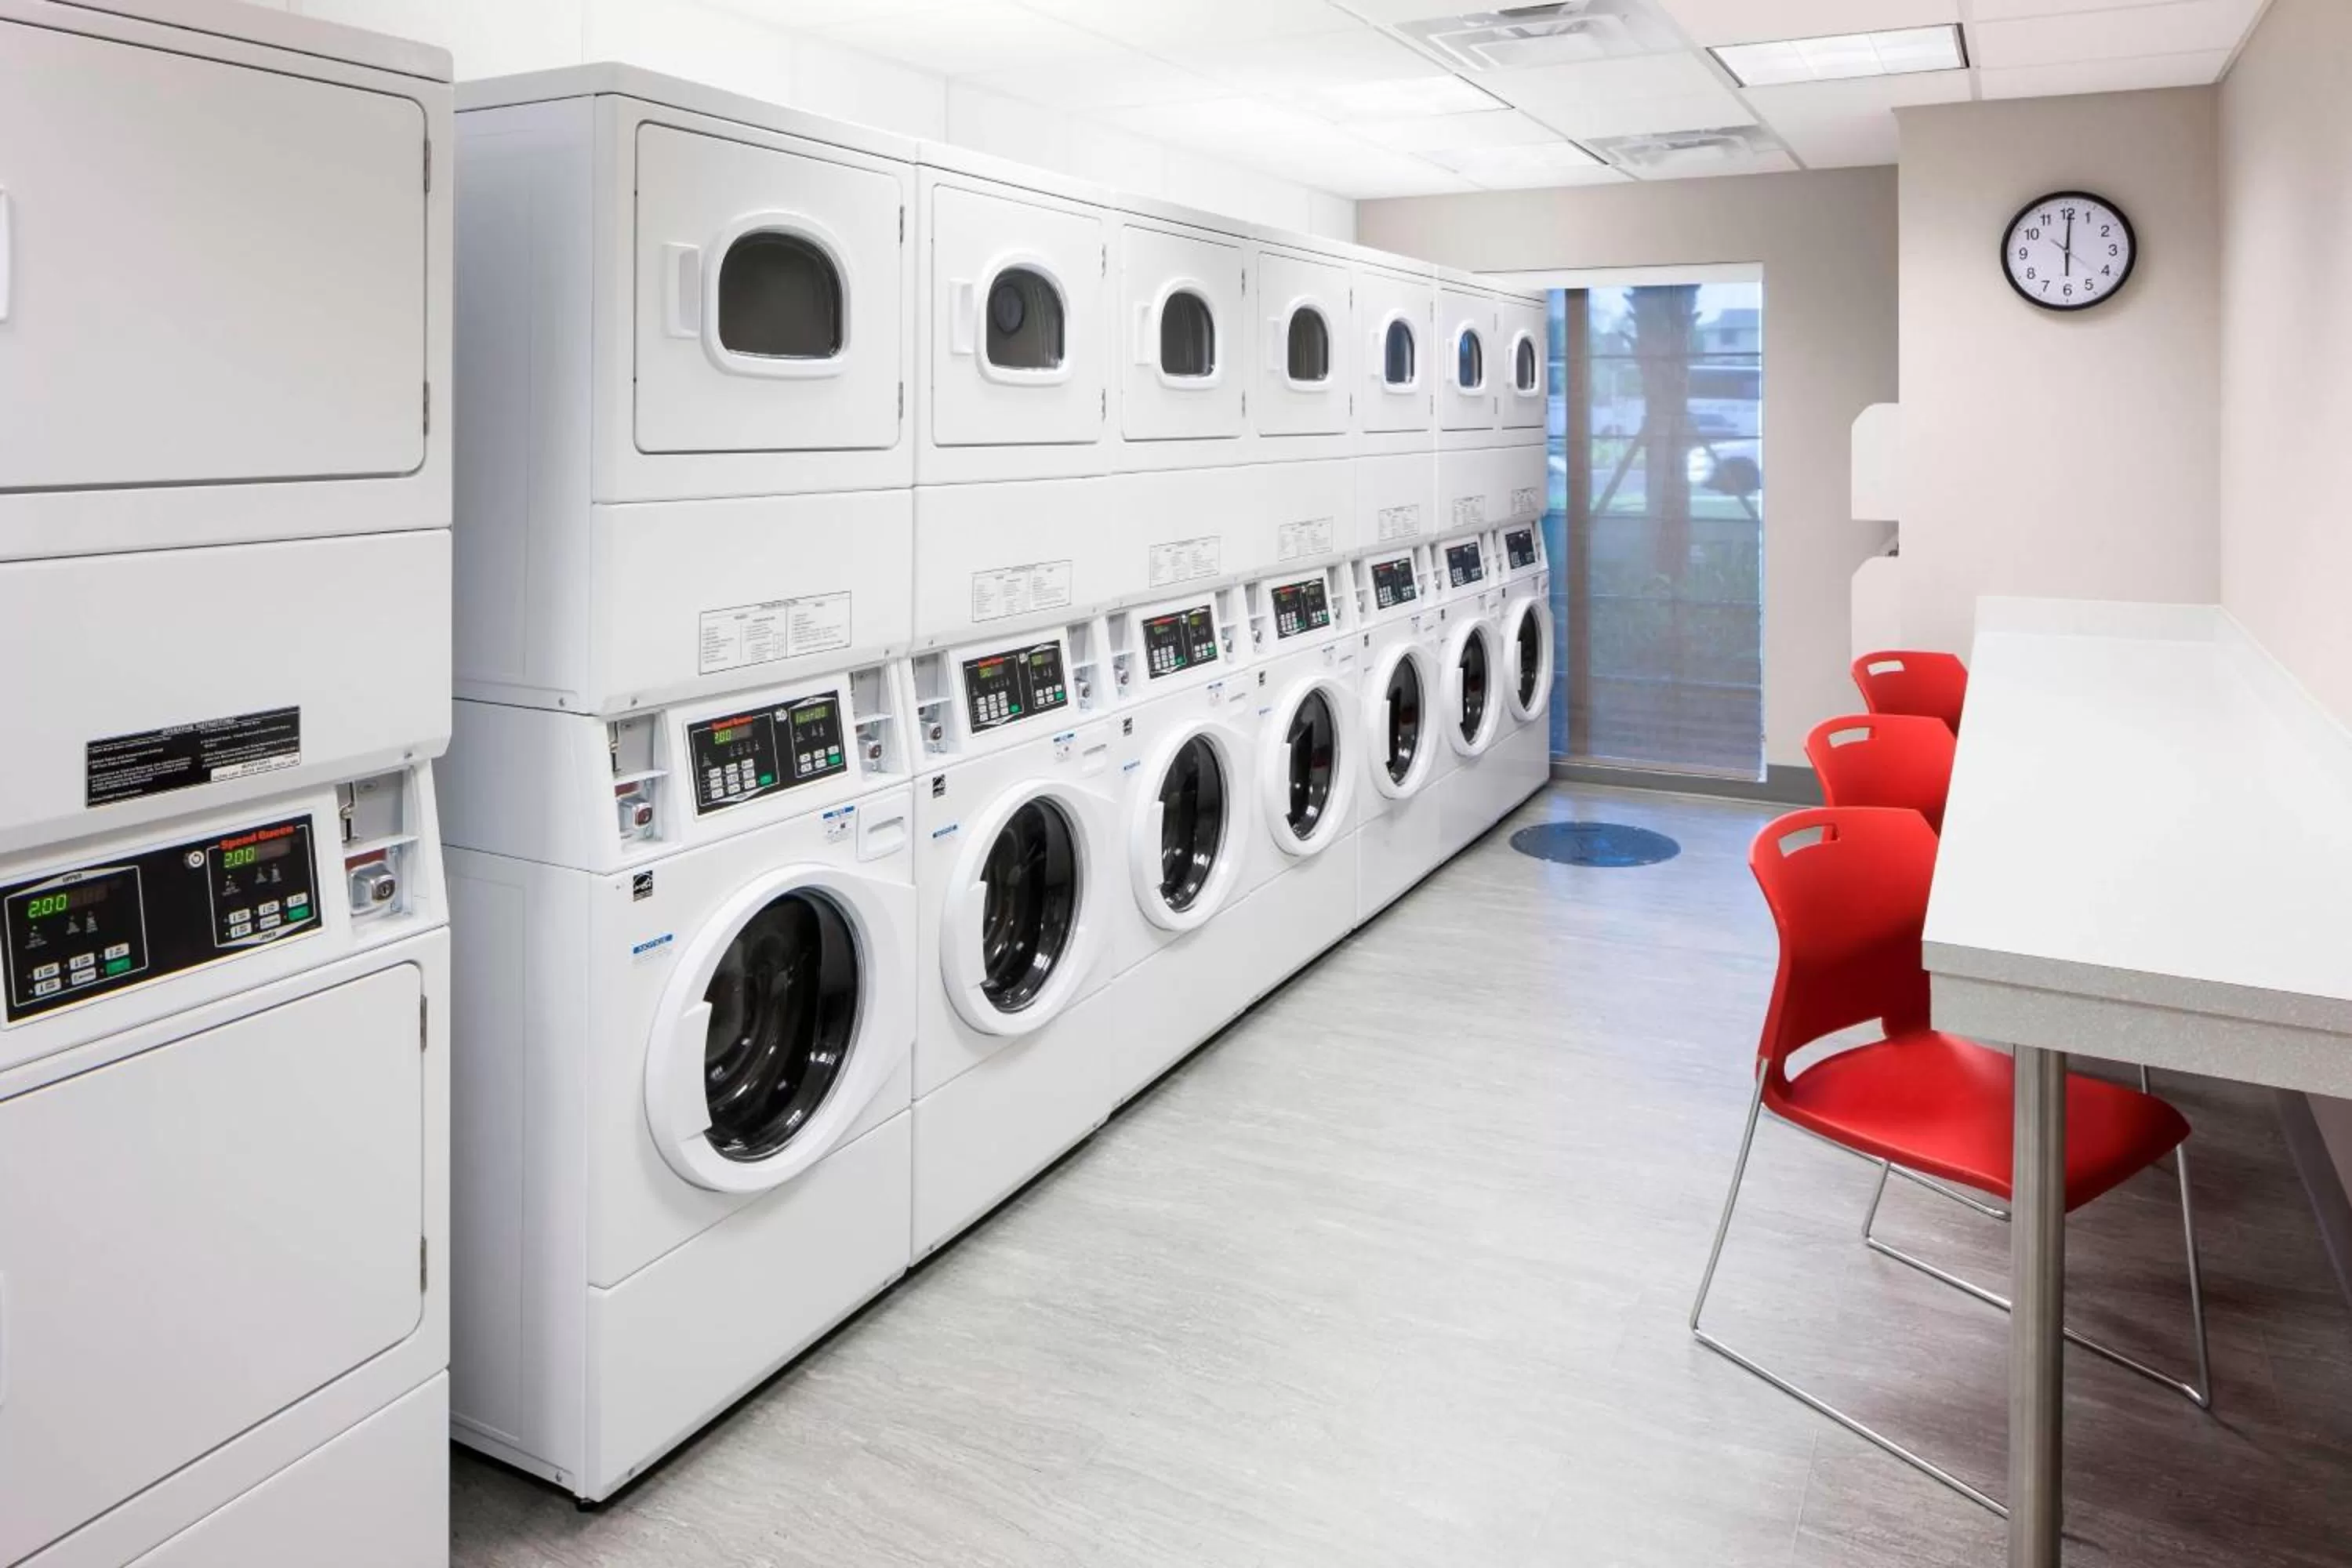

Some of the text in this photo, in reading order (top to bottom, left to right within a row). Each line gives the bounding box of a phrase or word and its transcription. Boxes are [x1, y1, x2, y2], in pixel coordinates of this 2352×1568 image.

[2040, 214, 2051, 226] 11
[2060, 208, 2075, 220] 12
[2085, 212, 2091, 223] 1
[2024, 228, 2039, 241] 10
[2100, 225, 2110, 238] 2
[2019, 247, 2028, 260] 9
[2108, 244, 2118, 256] 3
[2027, 267, 2036, 280] 8
[2101, 264, 2110, 276] 4
[2042, 280, 2050, 292] 7
[2063, 284, 2072, 296] 6
[2085, 278, 2093, 290] 5
[220, 826, 294, 851] Speed Queen
[28, 894, 67, 919] 2.00
